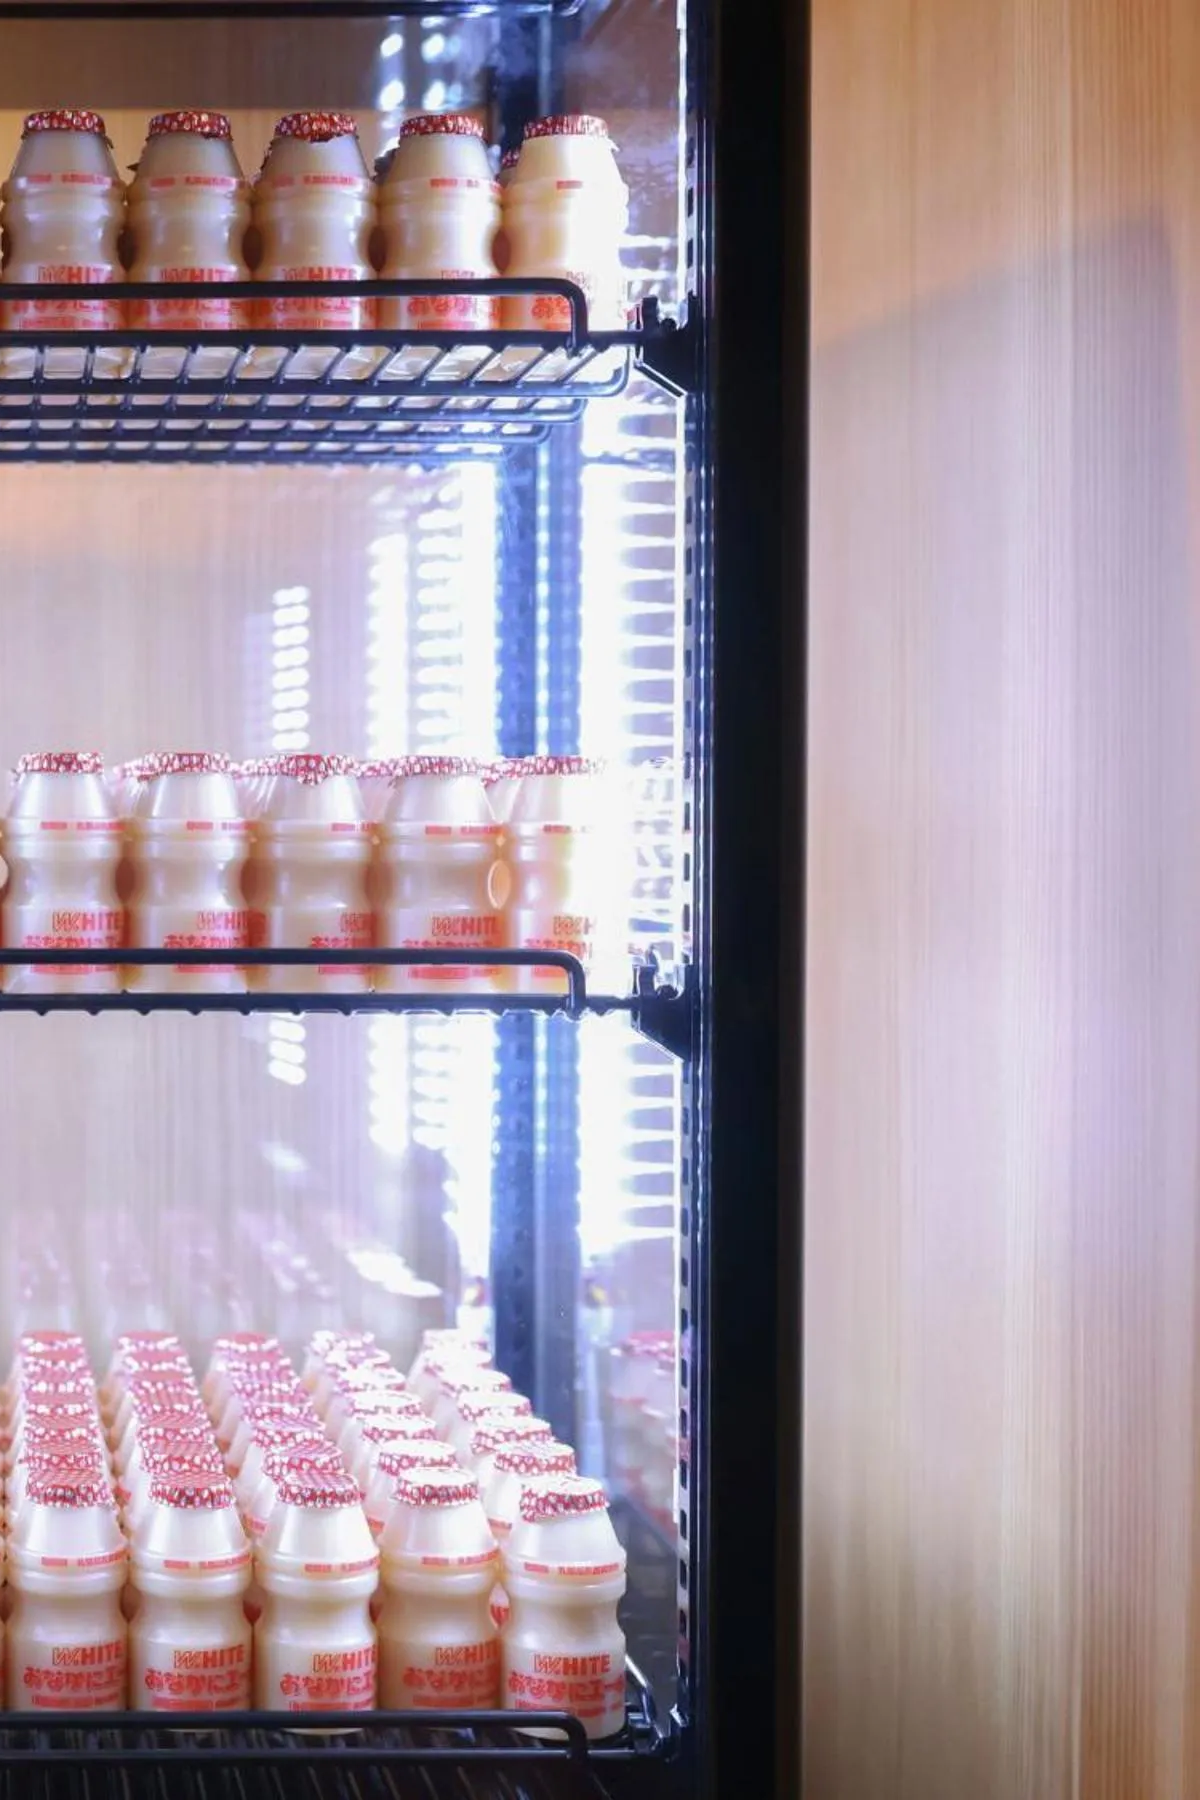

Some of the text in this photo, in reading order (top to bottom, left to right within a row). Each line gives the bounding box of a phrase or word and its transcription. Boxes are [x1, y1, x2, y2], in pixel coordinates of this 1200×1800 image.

[52, 1640, 123, 1666] WHITE
[173, 1643, 244, 1669] WHITE
[534, 1652, 611, 1676] WHITE
